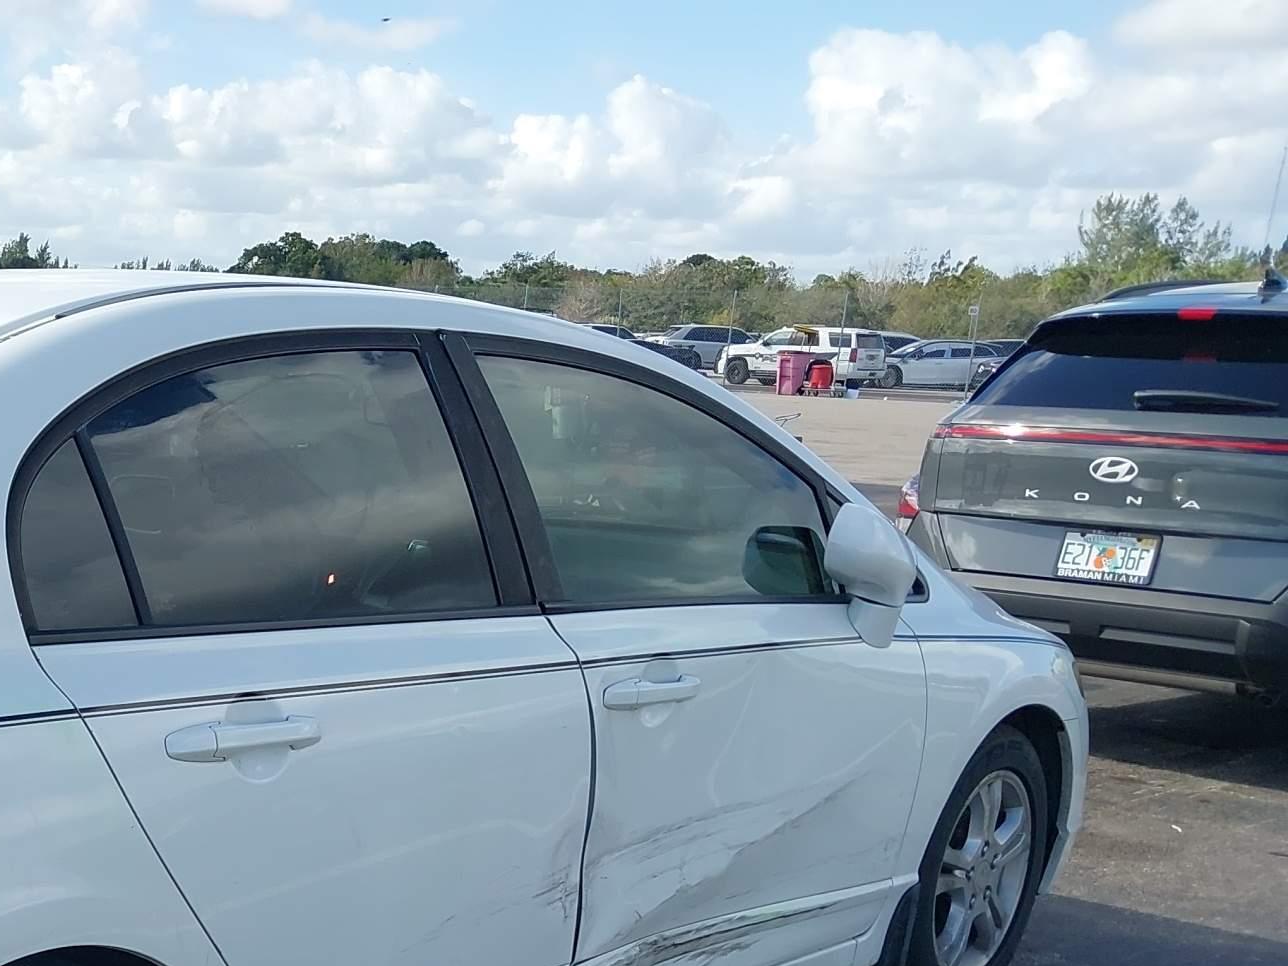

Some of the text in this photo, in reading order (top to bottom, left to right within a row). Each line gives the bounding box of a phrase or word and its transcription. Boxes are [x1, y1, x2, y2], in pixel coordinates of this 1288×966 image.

[1025, 488, 1200, 510] KONA
[1058, 568, 1145, 585] BRAMAN MIAMI
